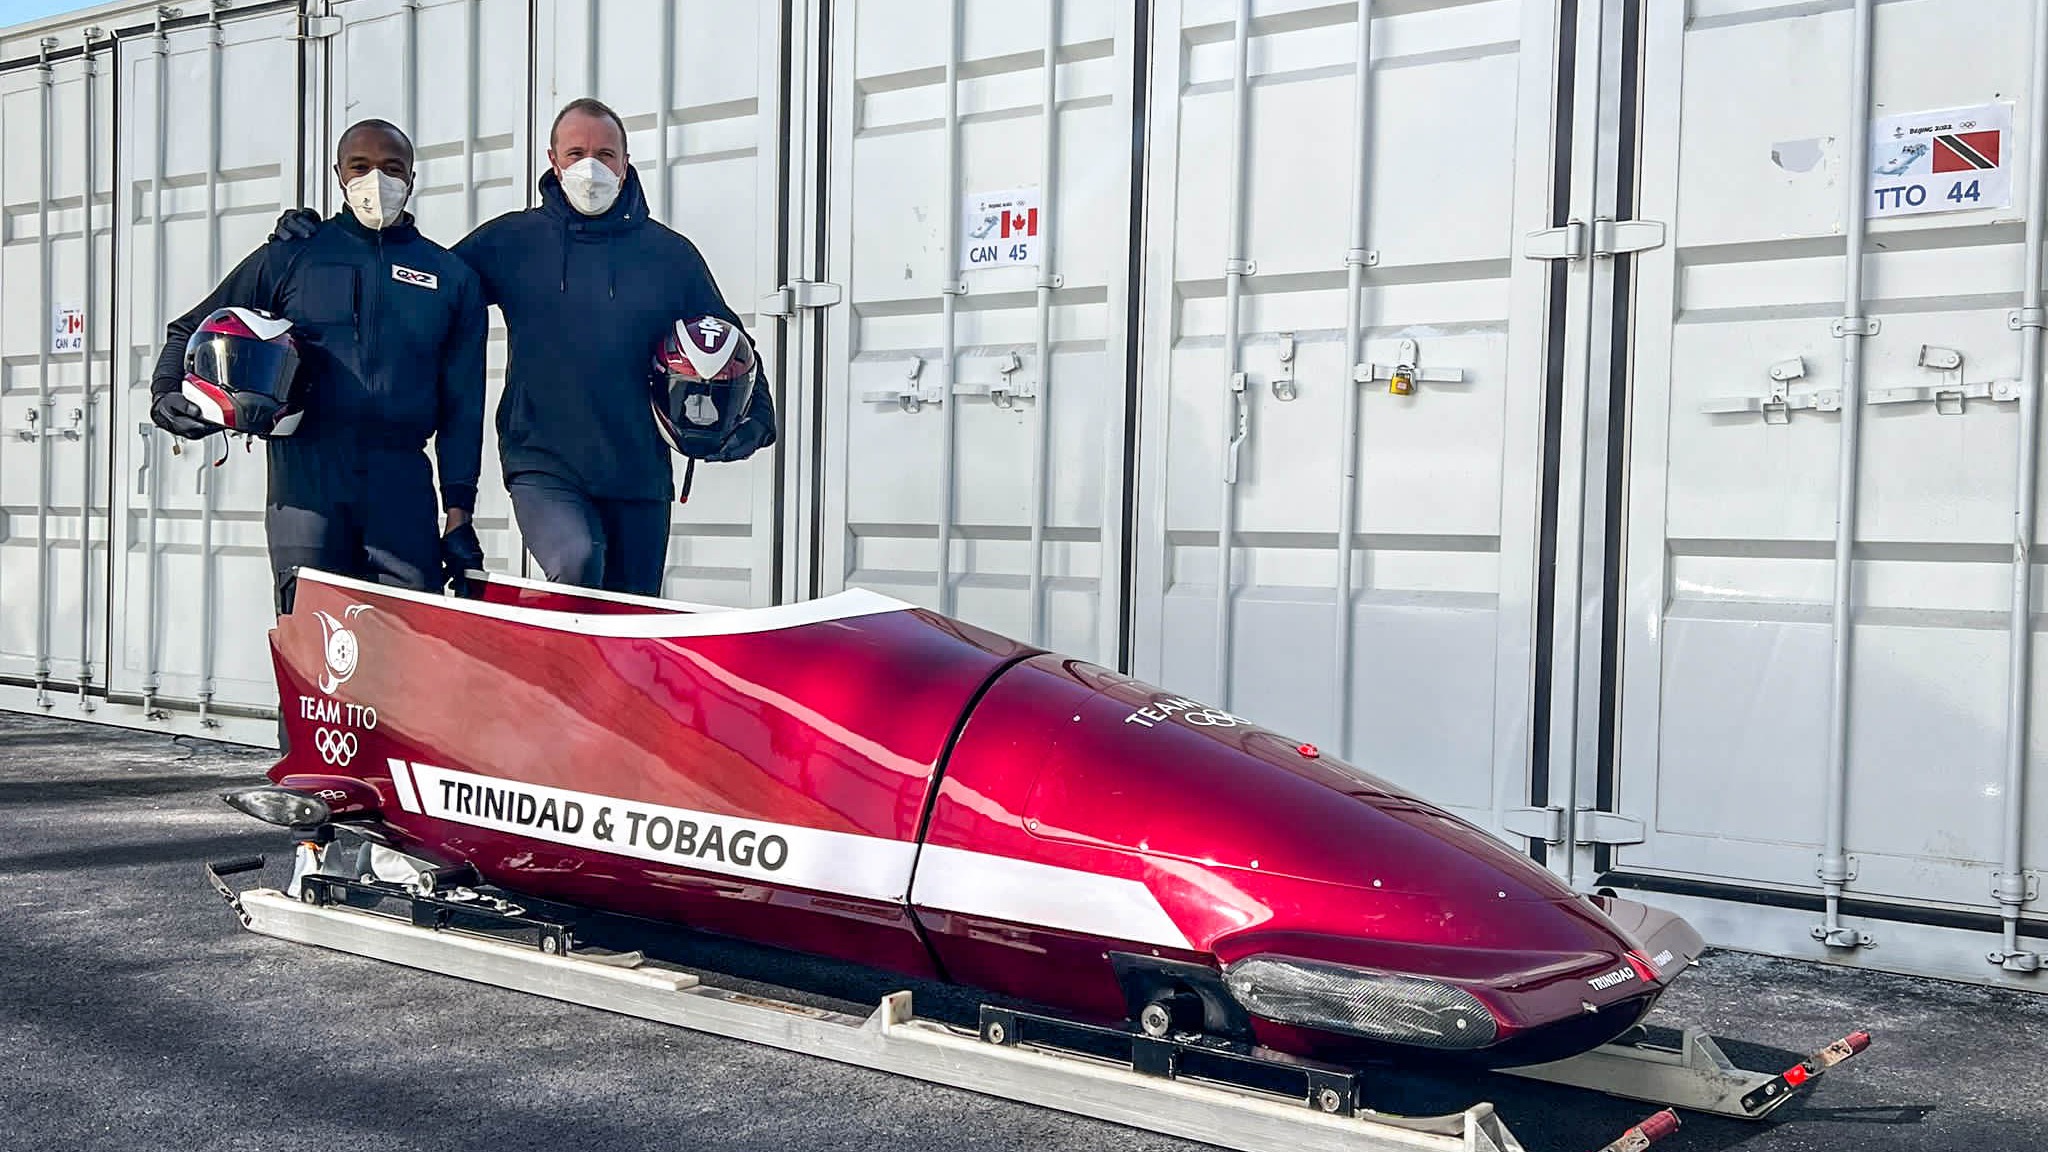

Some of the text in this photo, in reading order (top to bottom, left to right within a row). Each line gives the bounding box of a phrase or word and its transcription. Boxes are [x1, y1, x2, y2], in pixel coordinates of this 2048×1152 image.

[1874, 179, 1981, 210] TTO 44
[970, 243, 1027, 263] CAN 45
[55, 338, 69, 349] CAN
[299, 695, 377, 730] TEAM TTO
[439, 779, 788, 871] TRINIDAD & TOBAGO
[1587, 966, 1635, 991] TRINIDAD
